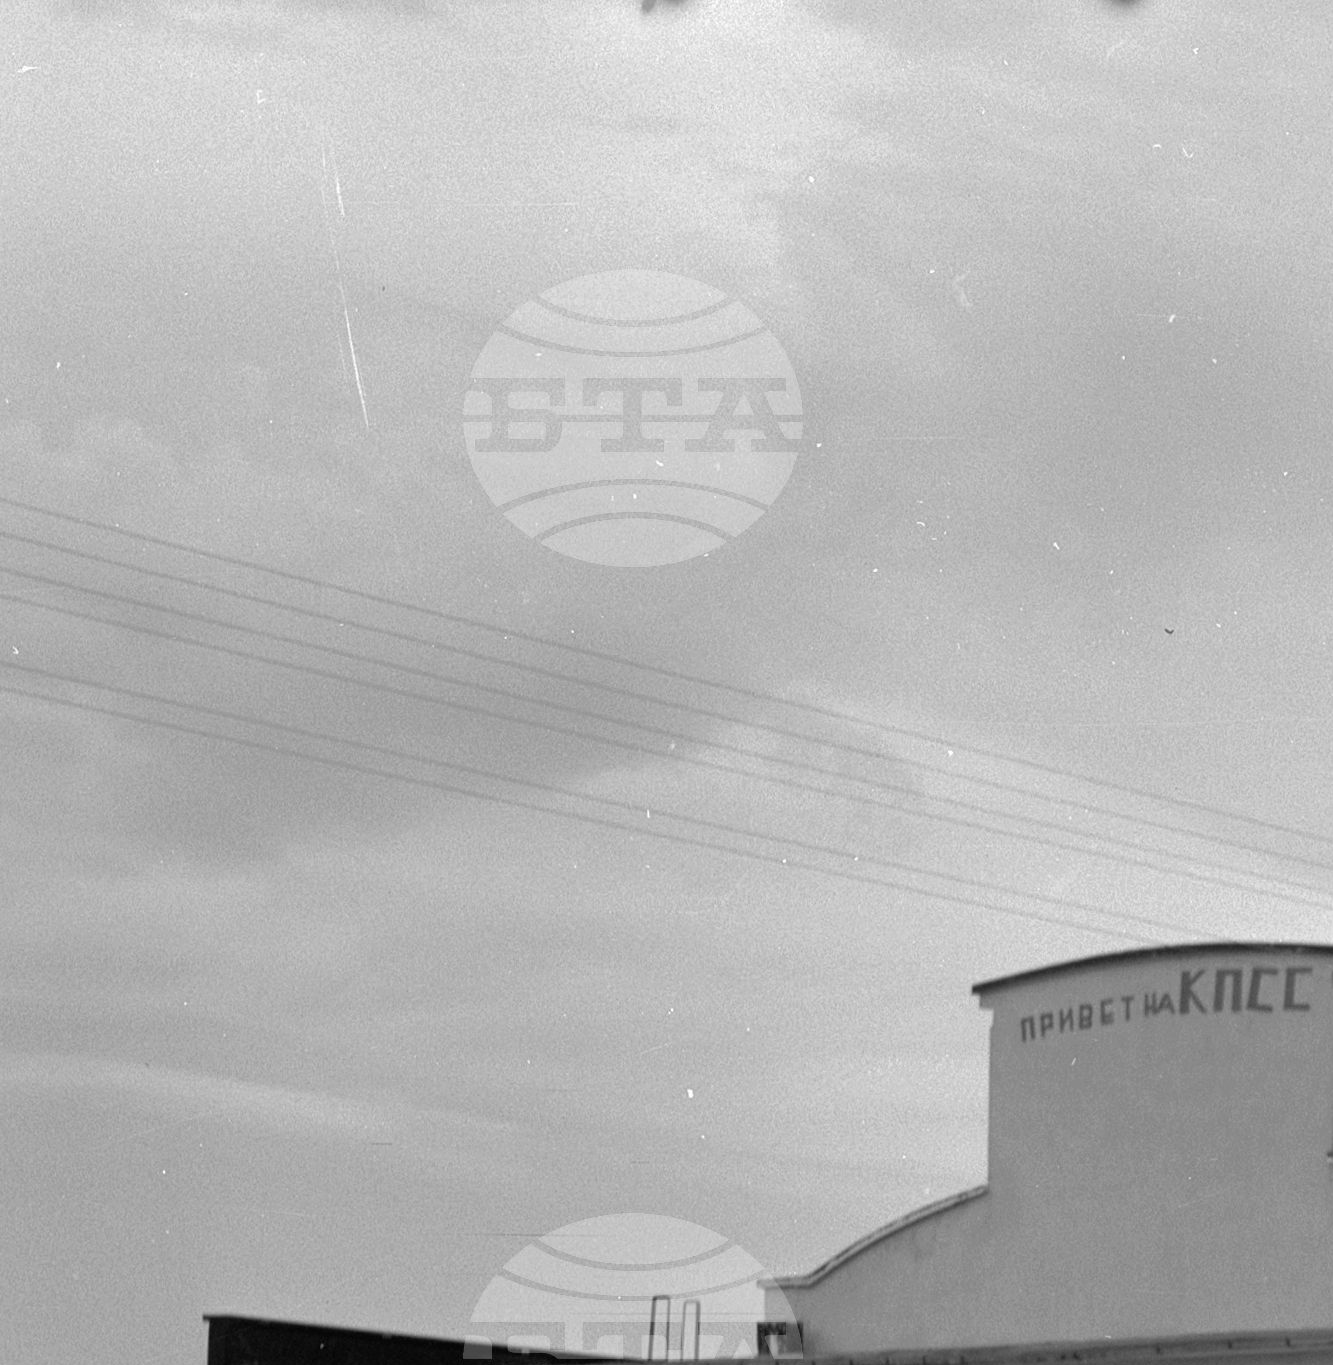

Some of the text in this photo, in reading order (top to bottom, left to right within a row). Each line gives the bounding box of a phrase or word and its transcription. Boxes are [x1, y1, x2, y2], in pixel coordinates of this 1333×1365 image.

[1020, 966, 1314, 1043] ПРИВЕТ НА КПСС
